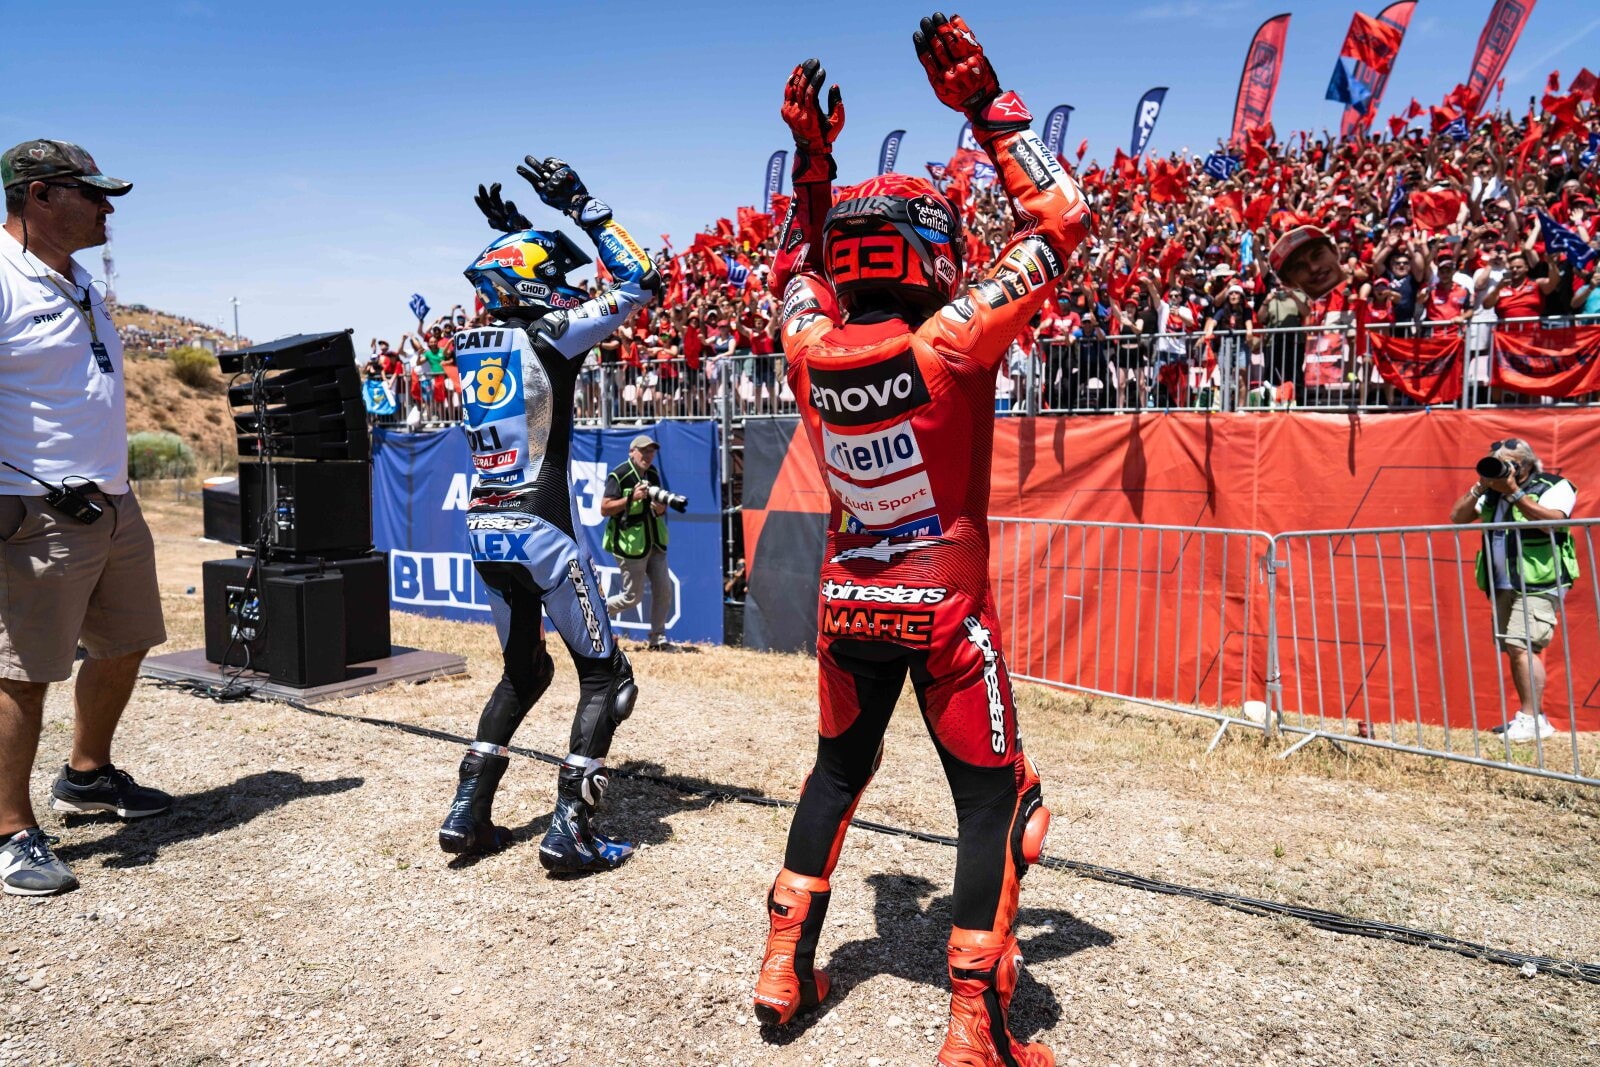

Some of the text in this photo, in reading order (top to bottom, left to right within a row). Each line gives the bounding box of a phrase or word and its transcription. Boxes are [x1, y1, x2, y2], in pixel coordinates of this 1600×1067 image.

[1016, 144, 1050, 186] Lenovo
[1028, 137, 1061, 174] Unipol
[914, 203, 948, 221] Estrella
[918, 212, 948, 233] Galicia
[939, 260, 955, 280] SHOEI
[520, 284, 546, 296] SHOEI
[33, 313, 64, 324] STAFF
[497, 453, 513, 465] OIL
[843, 487, 927, 512] Audi Sport
[822, 580, 947, 604] alpinestars
[568, 559, 605, 653] alpinestars
[963, 616, 1006, 754] alpinestars
